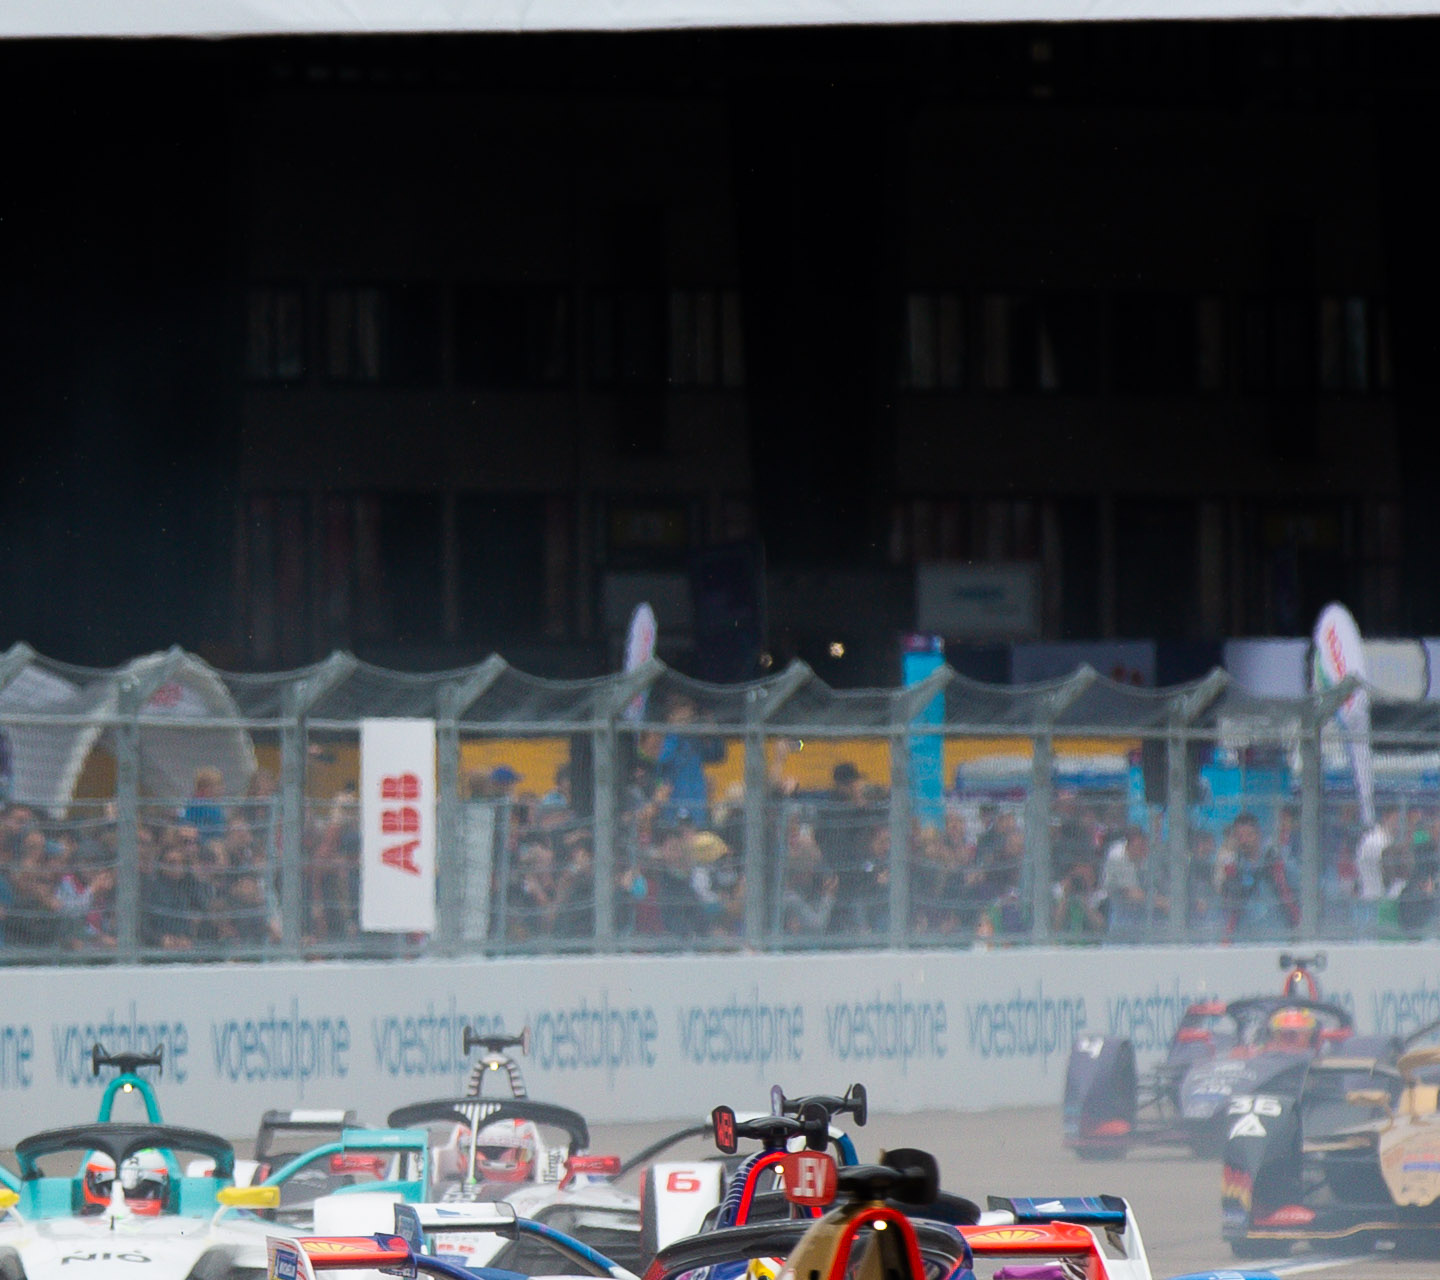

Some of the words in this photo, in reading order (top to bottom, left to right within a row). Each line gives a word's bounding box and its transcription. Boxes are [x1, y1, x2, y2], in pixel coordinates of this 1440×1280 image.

[379, 772, 422, 877] ABB
[210, 994, 351, 1100] voestalpine
[372, 993, 505, 1097] voestalp
[525, 985, 658, 1089] voestalpine
[679, 981, 804, 1084] voestalpine
[826, 978, 948, 1077] voestalpine
[967, 977, 1088, 1074] voestalpine
[1077, 1037, 1104, 1059] 4
[1228, 1097, 1282, 1117] 36
[666, 1171, 701, 1192] 6
[792, 1156, 828, 1198] JEV
[62, 1251, 151, 1264] NIO
